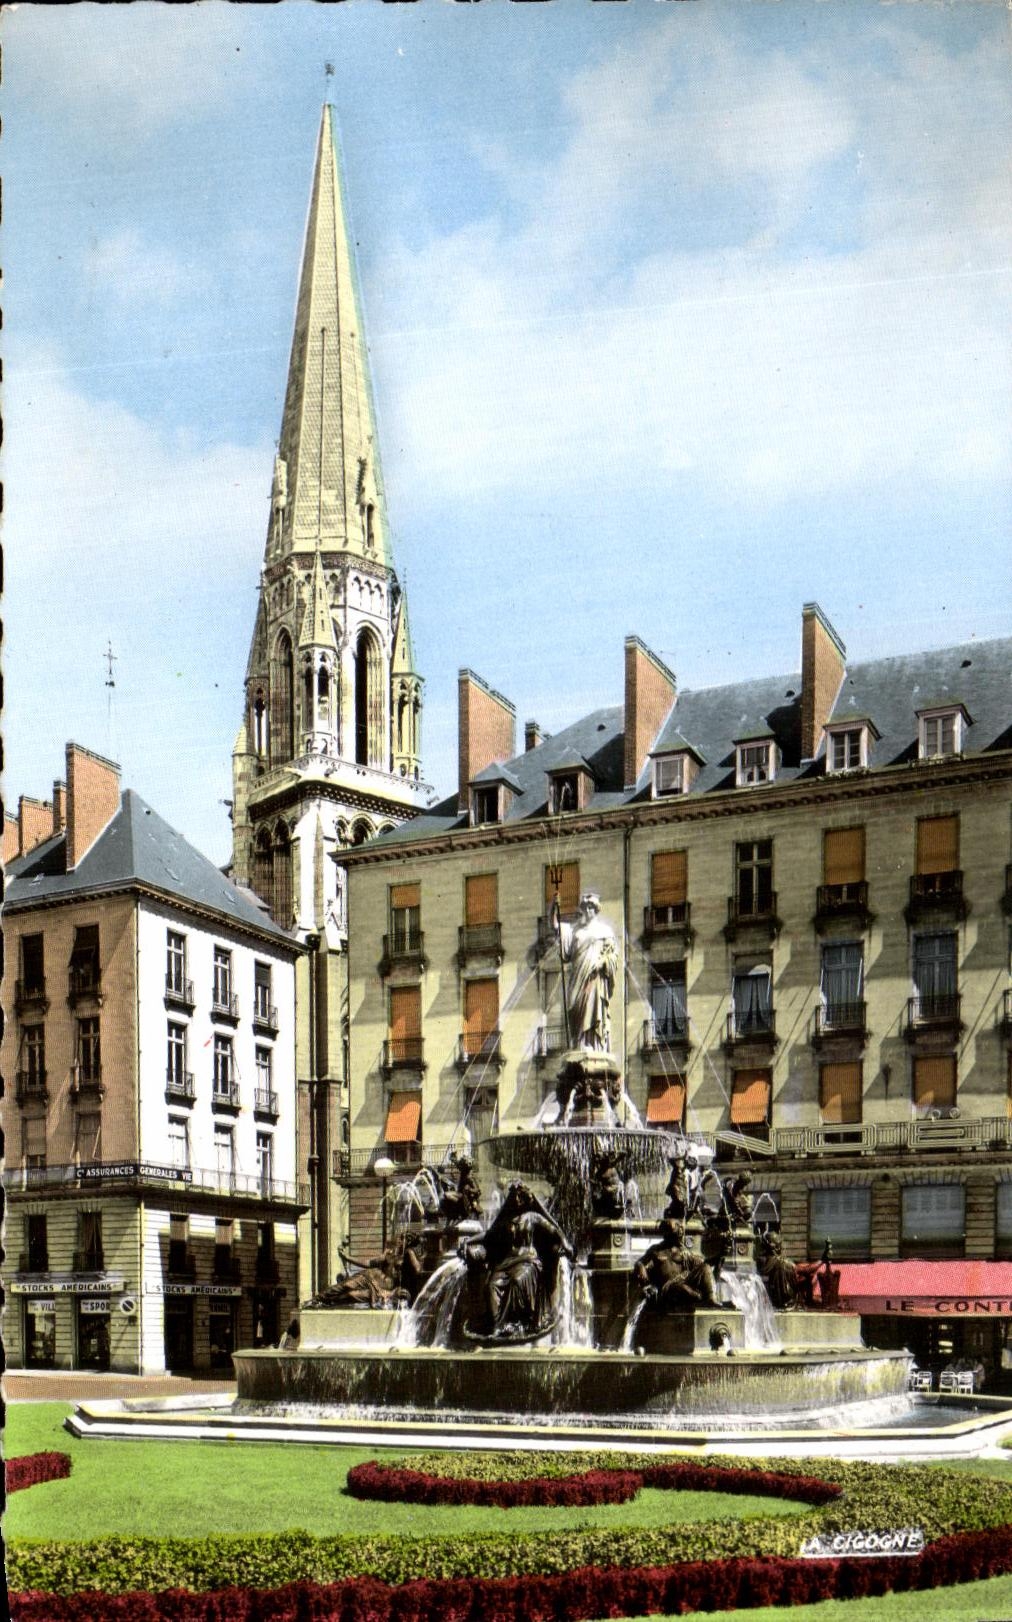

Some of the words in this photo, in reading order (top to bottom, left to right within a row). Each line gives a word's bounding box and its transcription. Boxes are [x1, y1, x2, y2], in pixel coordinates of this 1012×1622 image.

[86, 1166, 134, 1176] ASSURANCES
[140, 1166, 178, 1179] GENERALES
[182, 1172, 193, 1181] VIE
[886, 1301, 914, 1312] LE
